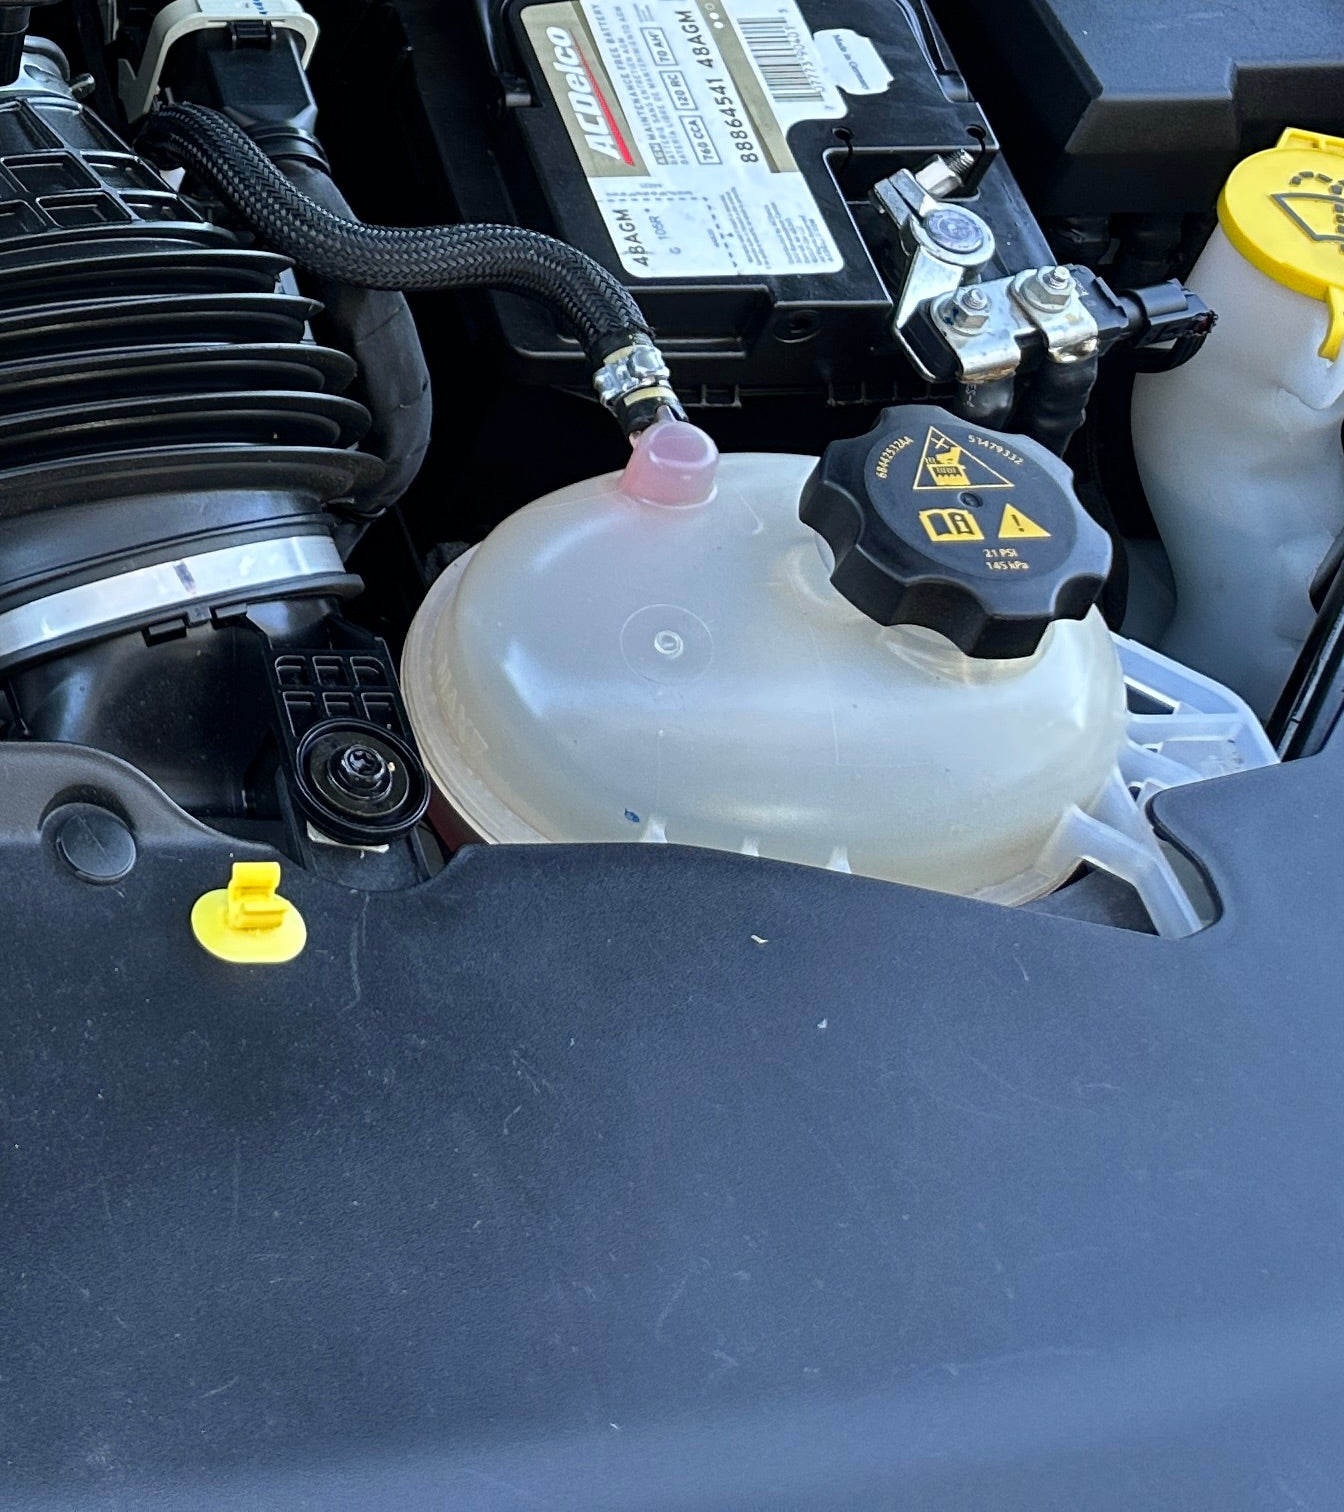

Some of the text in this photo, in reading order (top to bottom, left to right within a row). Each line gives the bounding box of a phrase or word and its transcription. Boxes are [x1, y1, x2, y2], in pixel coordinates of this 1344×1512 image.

[590, 4, 614, 42] BATTERY
[674, 10, 715, 67] 48AGM
[608, 46, 626, 69] FREE
[655, 49, 670, 61] 70
[545, 26, 620, 160] ACDelco
[620, 74, 657, 140] MAINTENANCE
[667, 74, 690, 106] 120 RC
[686, 119, 713, 160] 760 CCA
[705, 77, 759, 163] 88864541
[875, 436, 914, 479] 68442532AA
[983, 548, 1019, 558] 21 PSI
[986, 560, 1008, 570] 145
